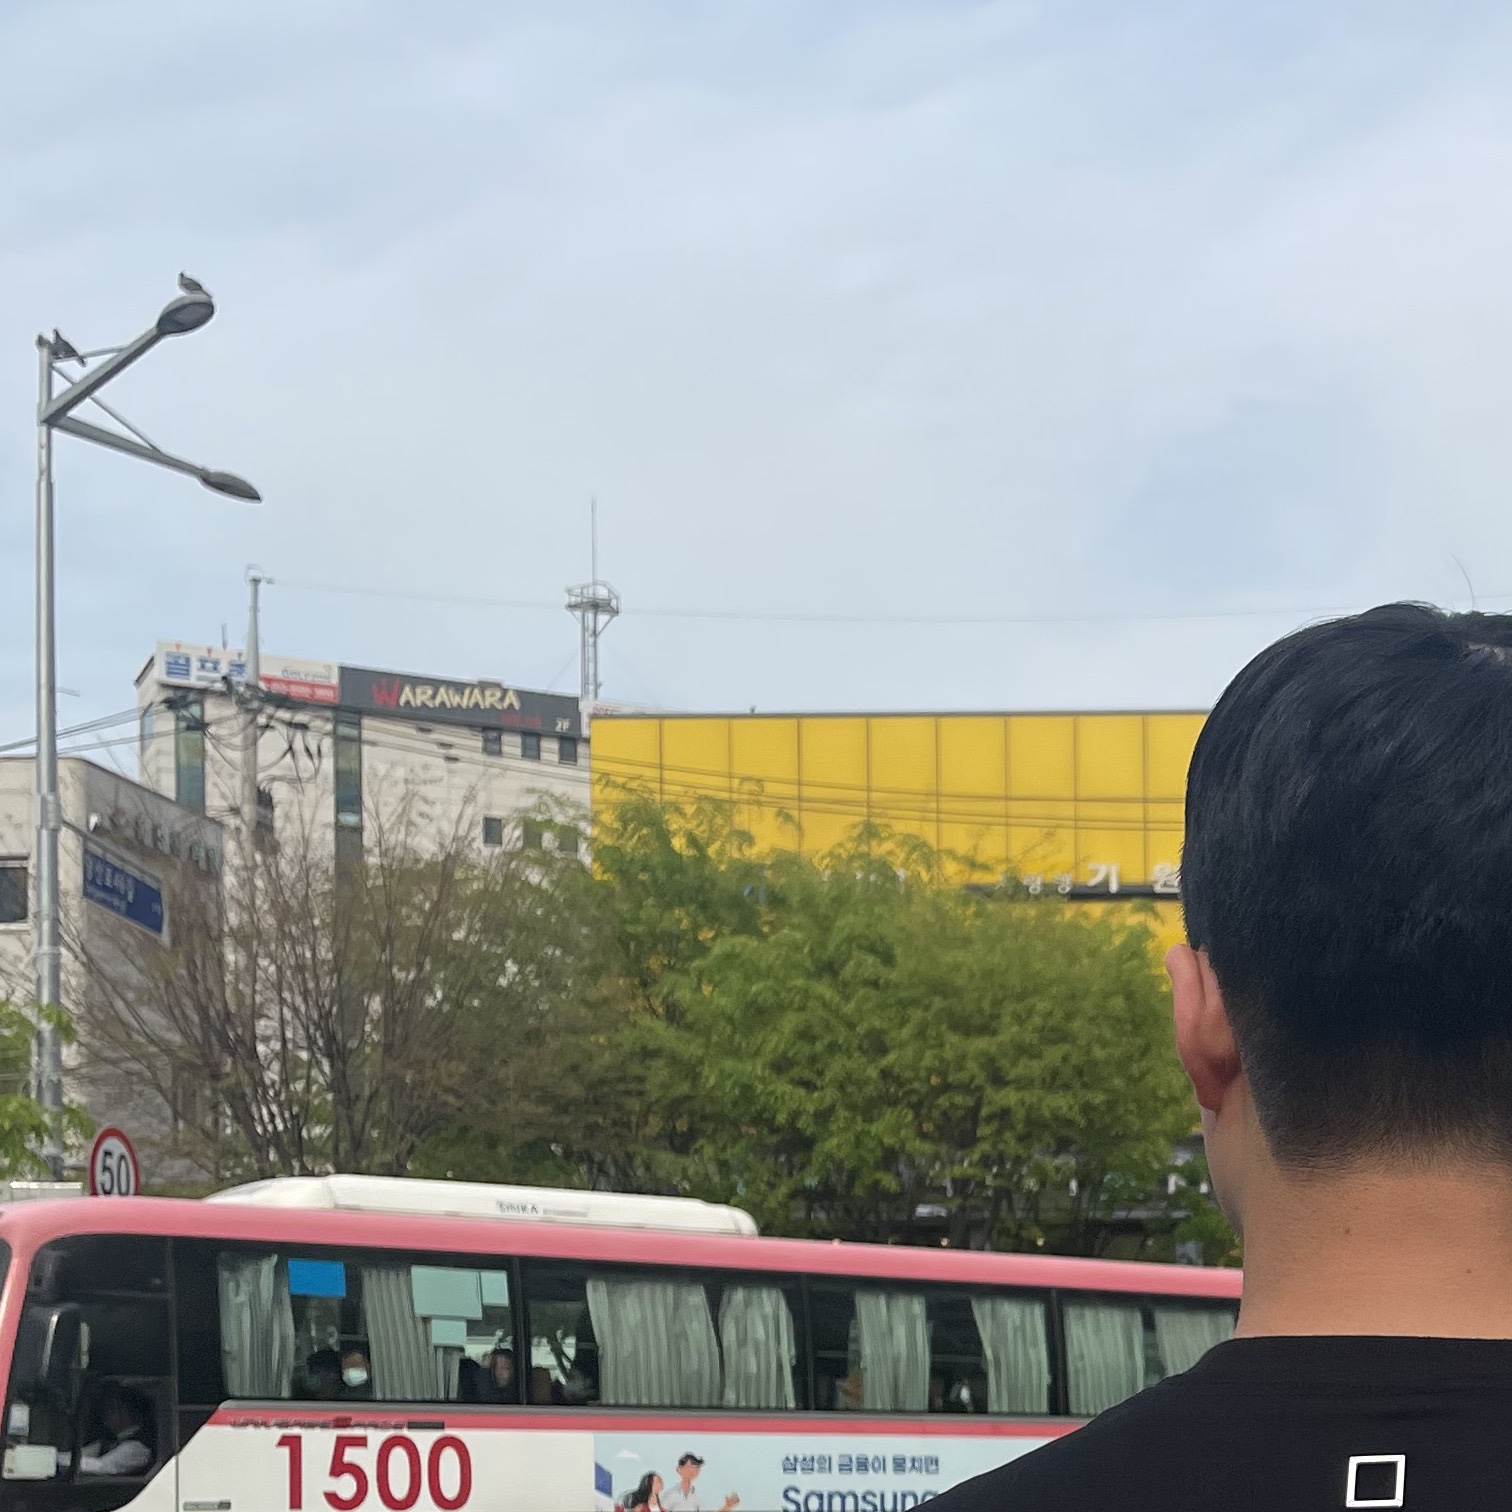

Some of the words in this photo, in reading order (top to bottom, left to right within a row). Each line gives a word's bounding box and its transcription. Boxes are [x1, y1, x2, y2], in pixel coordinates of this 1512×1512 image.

[371, 679, 521, 711] WARAWARA
[101, 1150, 130, 1196] 50
[276, 1434, 472, 1512] 1500
